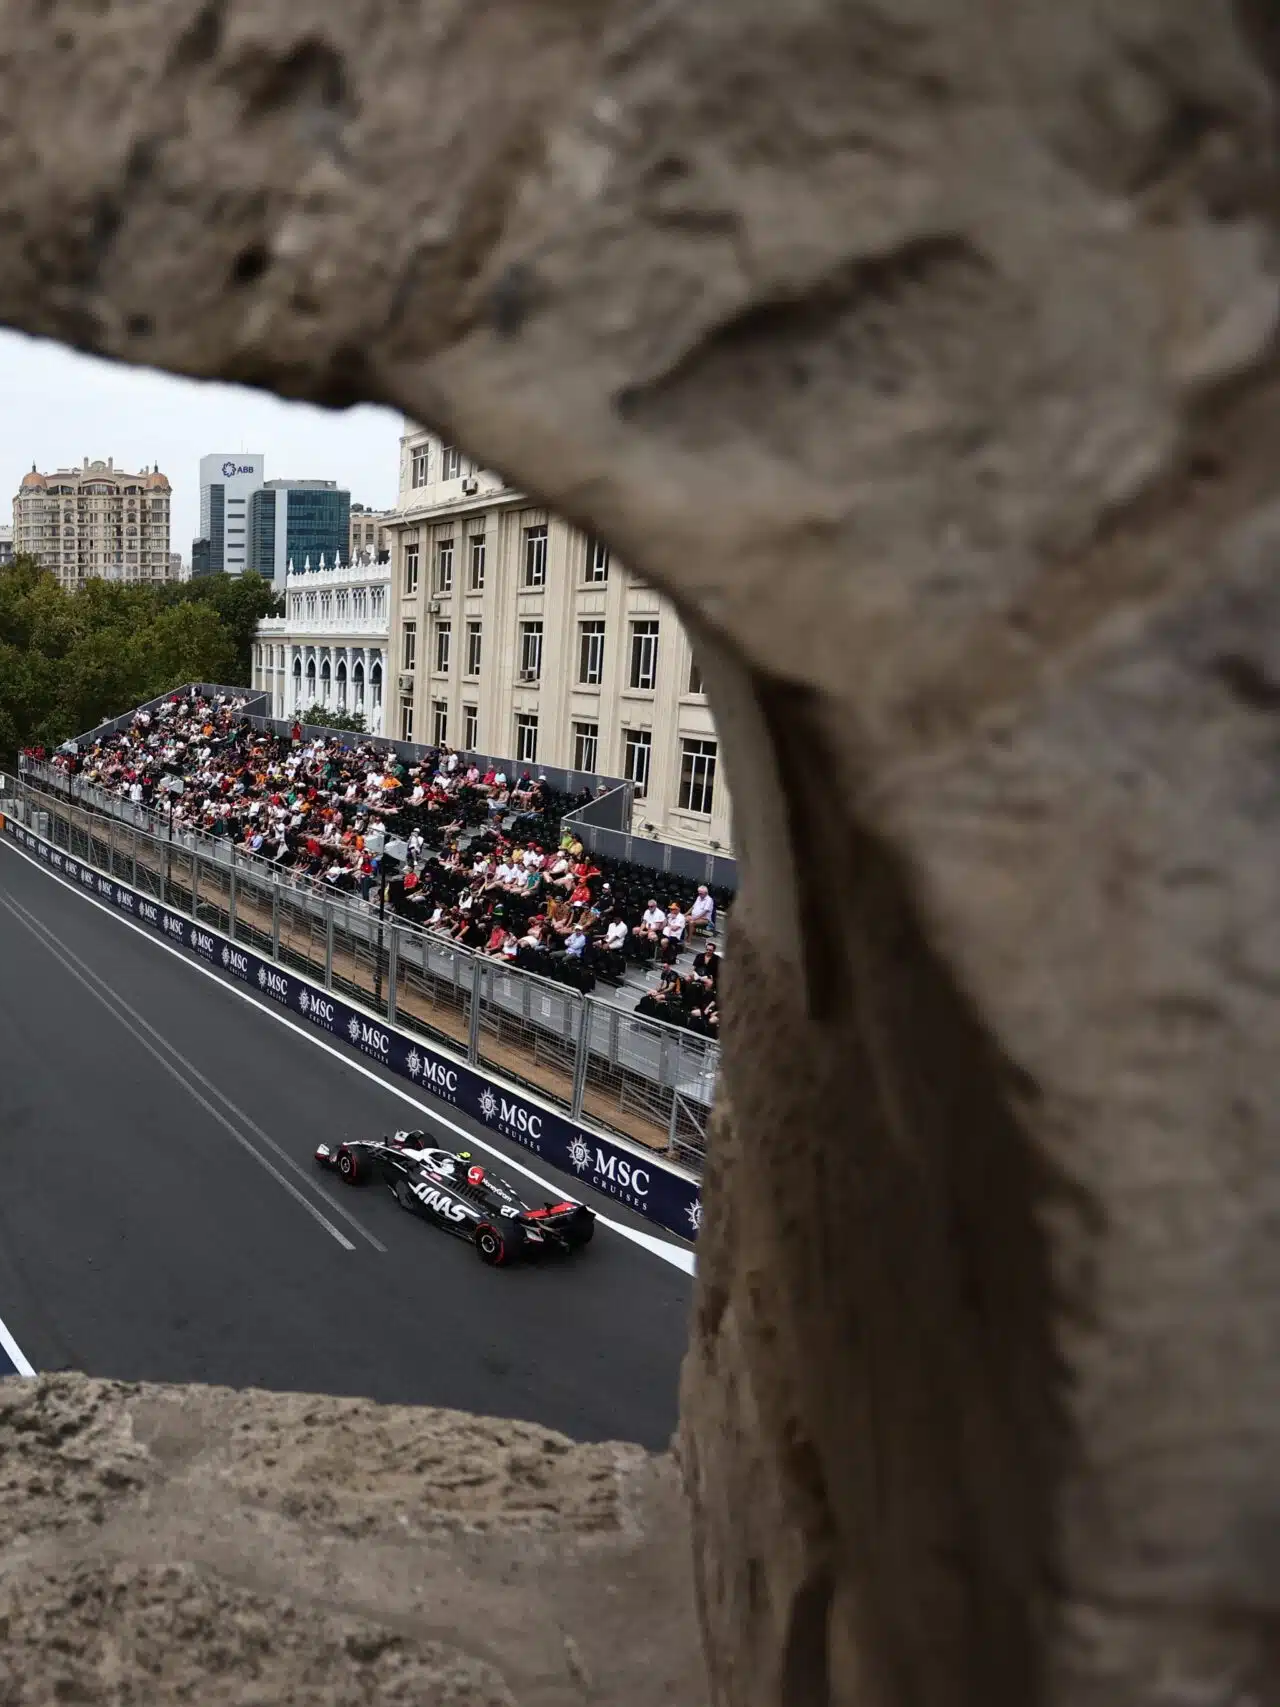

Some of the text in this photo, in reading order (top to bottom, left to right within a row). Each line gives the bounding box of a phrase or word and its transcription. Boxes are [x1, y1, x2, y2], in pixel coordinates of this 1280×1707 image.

[237, 466, 254, 474] ABB
[101, 879, 113, 896] MSC
[122, 891, 133, 907] MSC
[144, 902, 158, 921] MSC
[168, 916, 184, 936] MSC
[197, 931, 214, 953] MSC
[230, 950, 248, 972] MSC
[267, 971, 288, 996] MSC
[310, 994, 334, 1023] MSC
[361, 1022, 390, 1054] MSC
[360, 1042, 389, 1066] CRUISES
[422, 1056, 458, 1092] MSC
[422, 1078, 457, 1104] CRUISES
[499, 1097, 542, 1139] MSC
[498, 1121, 541, 1154] CRUISES
[594, 1147, 651, 1196] MSC
[408, 1182, 481, 1222] HAAS
[482, 1178, 513, 1202] MoneyGram
[592, 1175, 649, 1213] CRUISES
[500, 1204, 520, 1219] 27
